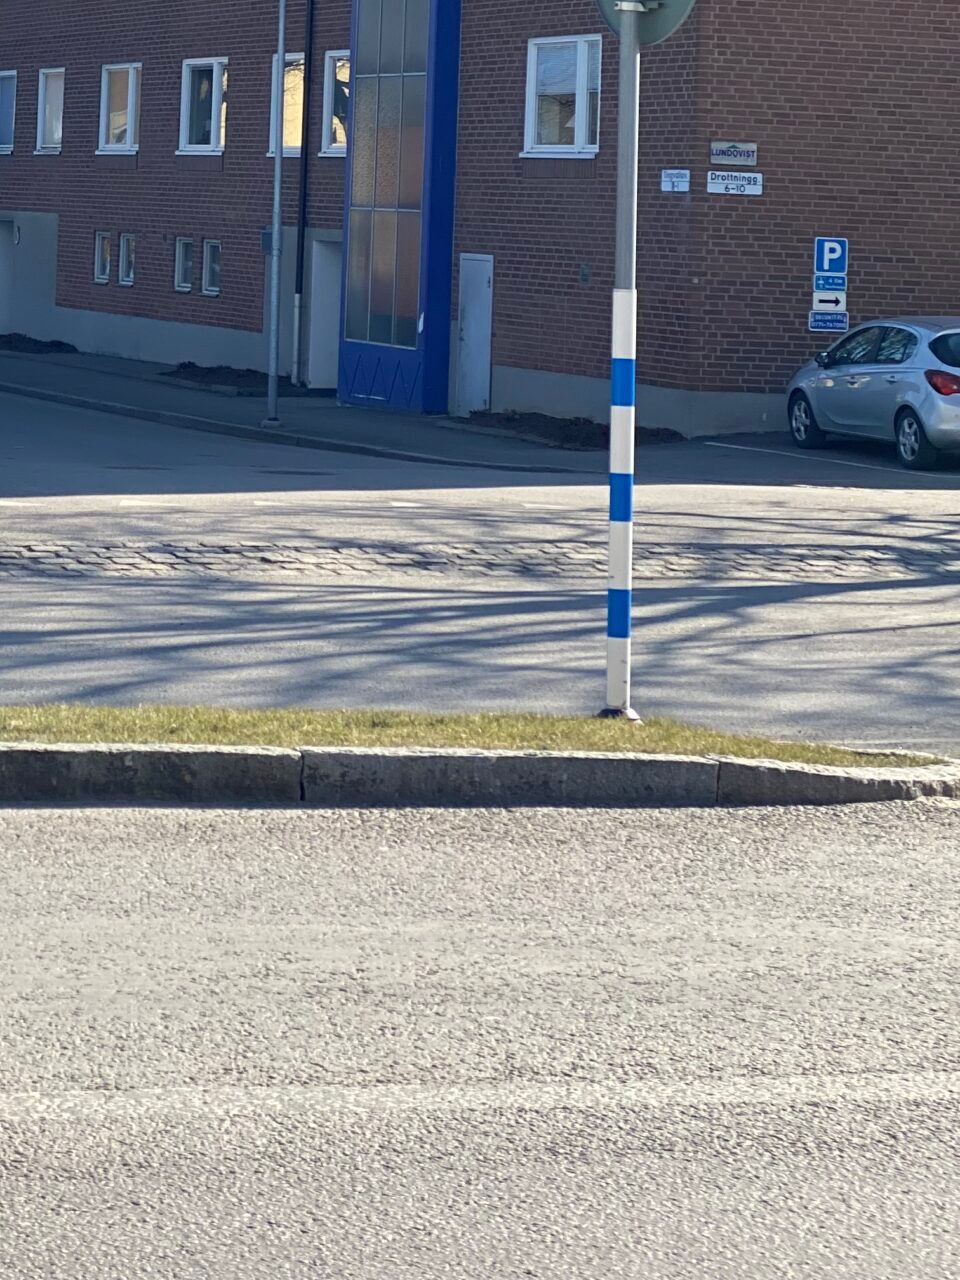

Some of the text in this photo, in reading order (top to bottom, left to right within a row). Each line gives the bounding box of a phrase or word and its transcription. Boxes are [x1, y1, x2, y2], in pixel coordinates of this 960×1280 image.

[711, 148, 756, 158] LUNDQVIST
[724, 184, 746, 193] 6-10
[823, 241, 842, 270] P
